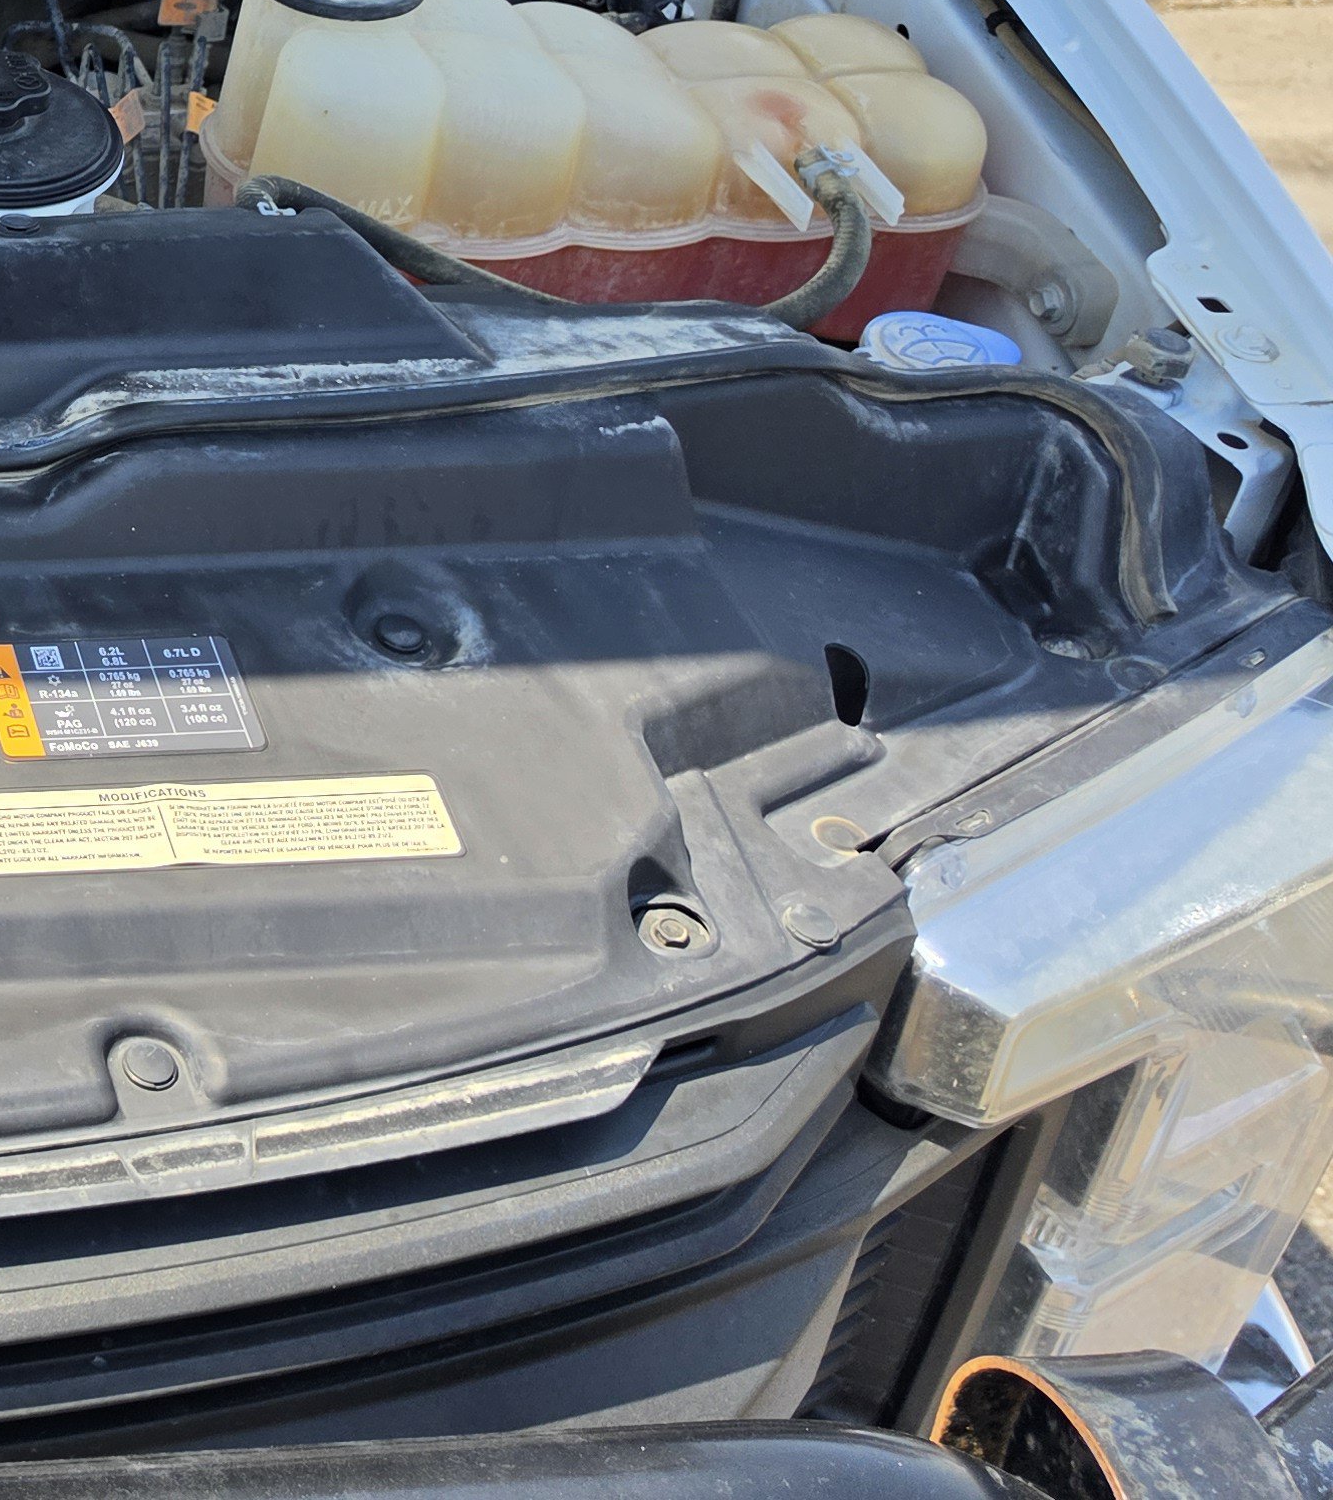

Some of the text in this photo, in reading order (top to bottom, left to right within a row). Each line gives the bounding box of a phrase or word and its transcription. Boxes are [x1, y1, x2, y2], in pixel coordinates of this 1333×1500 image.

[98, 646, 125, 656] 6.2L
[162, 647, 201, 658] 6.7L D
[98, 671, 141, 682] 0.765 kg
[168, 668, 211, 679] 0.765 kg
[110, 681, 121, 689] 27
[180, 678, 205, 686] 27 oz
[38, 689, 79, 699] R-134a
[109, 707, 126, 716] 4.1
[137, 707, 152, 715] oz
[179, 704, 198, 713] 3.4
[208, 704, 223, 712] oz
[56, 719, 83, 729] PAG
[113, 716, 157, 729] (120 cc)
[184, 713, 228, 726] (100 cc)
[48, 741, 99, 752] FoMoCo
[107, 740, 131, 749] SAE
[98, 788, 207, 802] MODIFICATIONS
